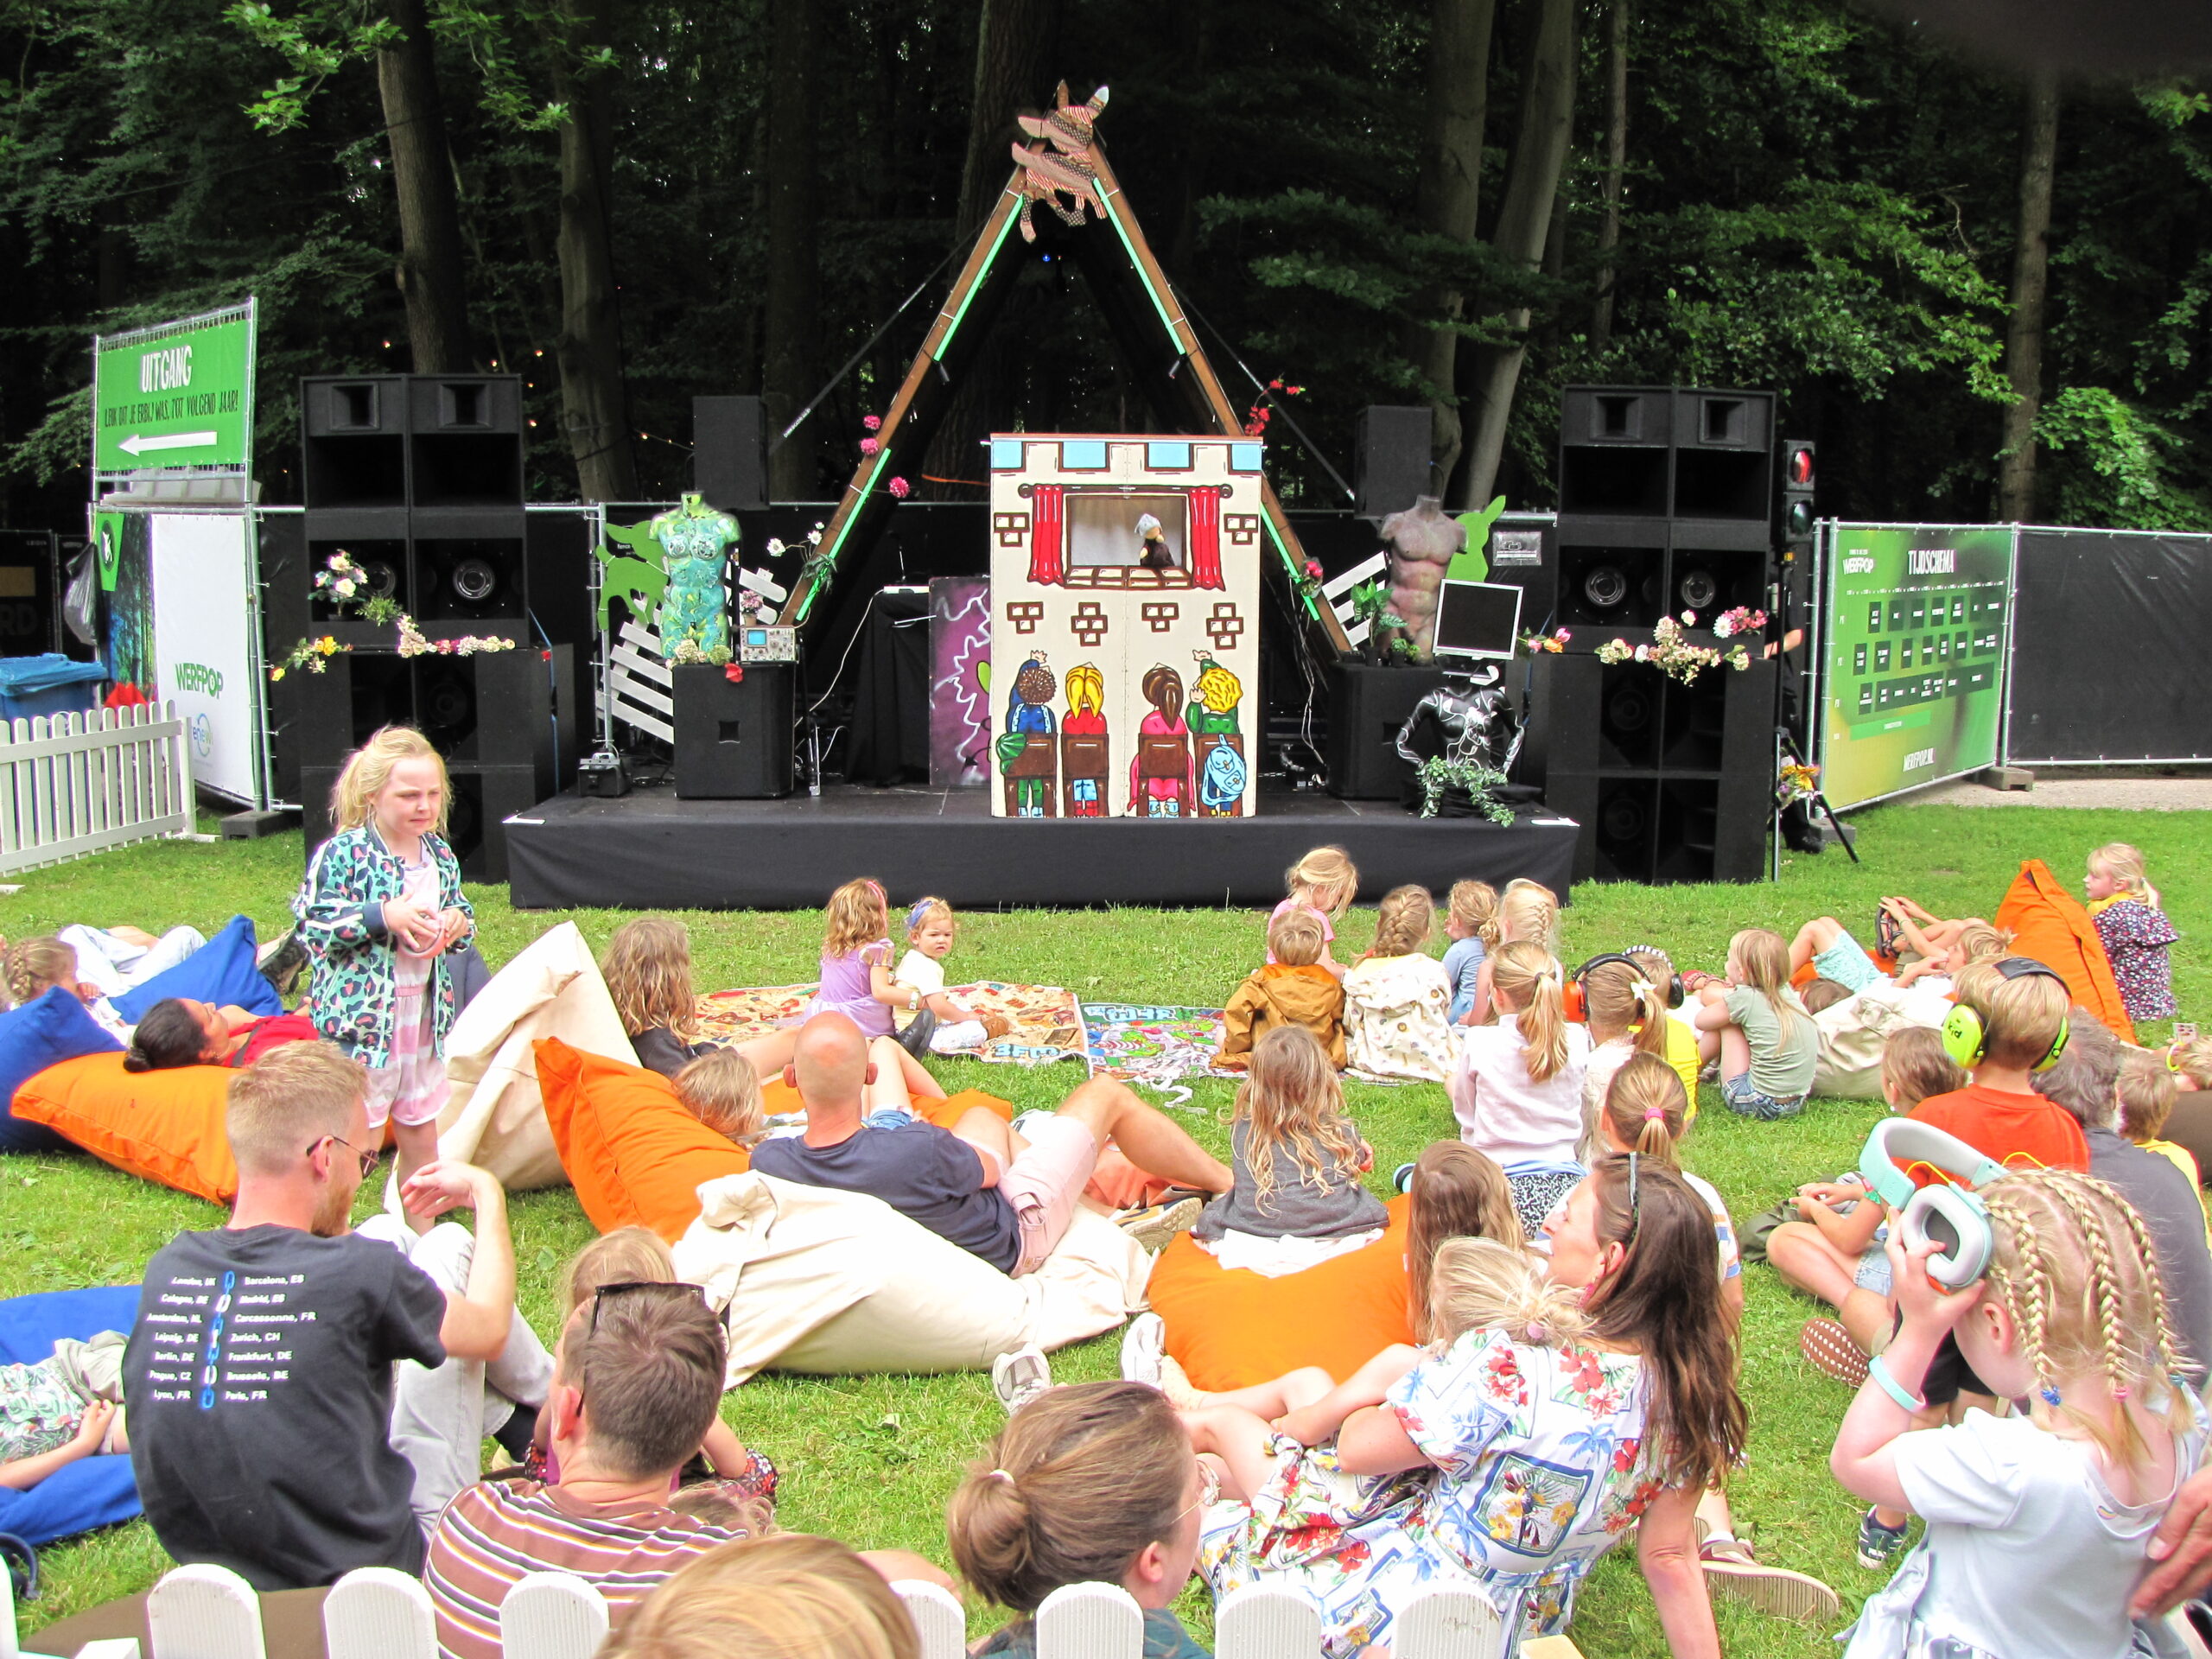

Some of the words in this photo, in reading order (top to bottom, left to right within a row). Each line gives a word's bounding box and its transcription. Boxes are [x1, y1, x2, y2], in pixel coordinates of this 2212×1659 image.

[140, 346, 193, 393] UITGANG
[129, 404, 136, 424] JE
[171, 397, 184, 419] TOT
[187, 392, 216, 416] VOLGEND
[219, 390, 238, 414] JAAR!
[1842, 557, 1874, 575] WERFPOP
[1908, 550, 1955, 575] TIJDSCHEMA
[175, 663, 224, 699] WERFPOP
[193, 727, 213, 745] enewi
[1903, 747, 1936, 772] WERFPOP.NL
[245, 1276, 289, 1286] Barcelona,
[290, 1274, 304, 1283] ES
[235, 1313, 298, 1323] Carcassonne,
[301, 1312, 316, 1320] FR
[155, 1332, 184, 1344] Leipzig,
[186, 1333, 200, 1343] DE
[264, 1332, 281, 1341] CH
[155, 1351, 180, 1362] Berlin,
[181, 1352, 195, 1362] DE
[228, 1351, 275, 1362] Frankfurt,
[276, 1351, 292, 1360] DE
[180, 1371, 192, 1381] CZ
[226, 1371, 270, 1381] Brussels,
[274, 1370, 289, 1379] BE
[154, 1389, 175, 1400] Lyon,
[176, 1390, 191, 1399] FR
[226, 1390, 249, 1401] Paris,
[251, 1390, 268, 1399] FR
